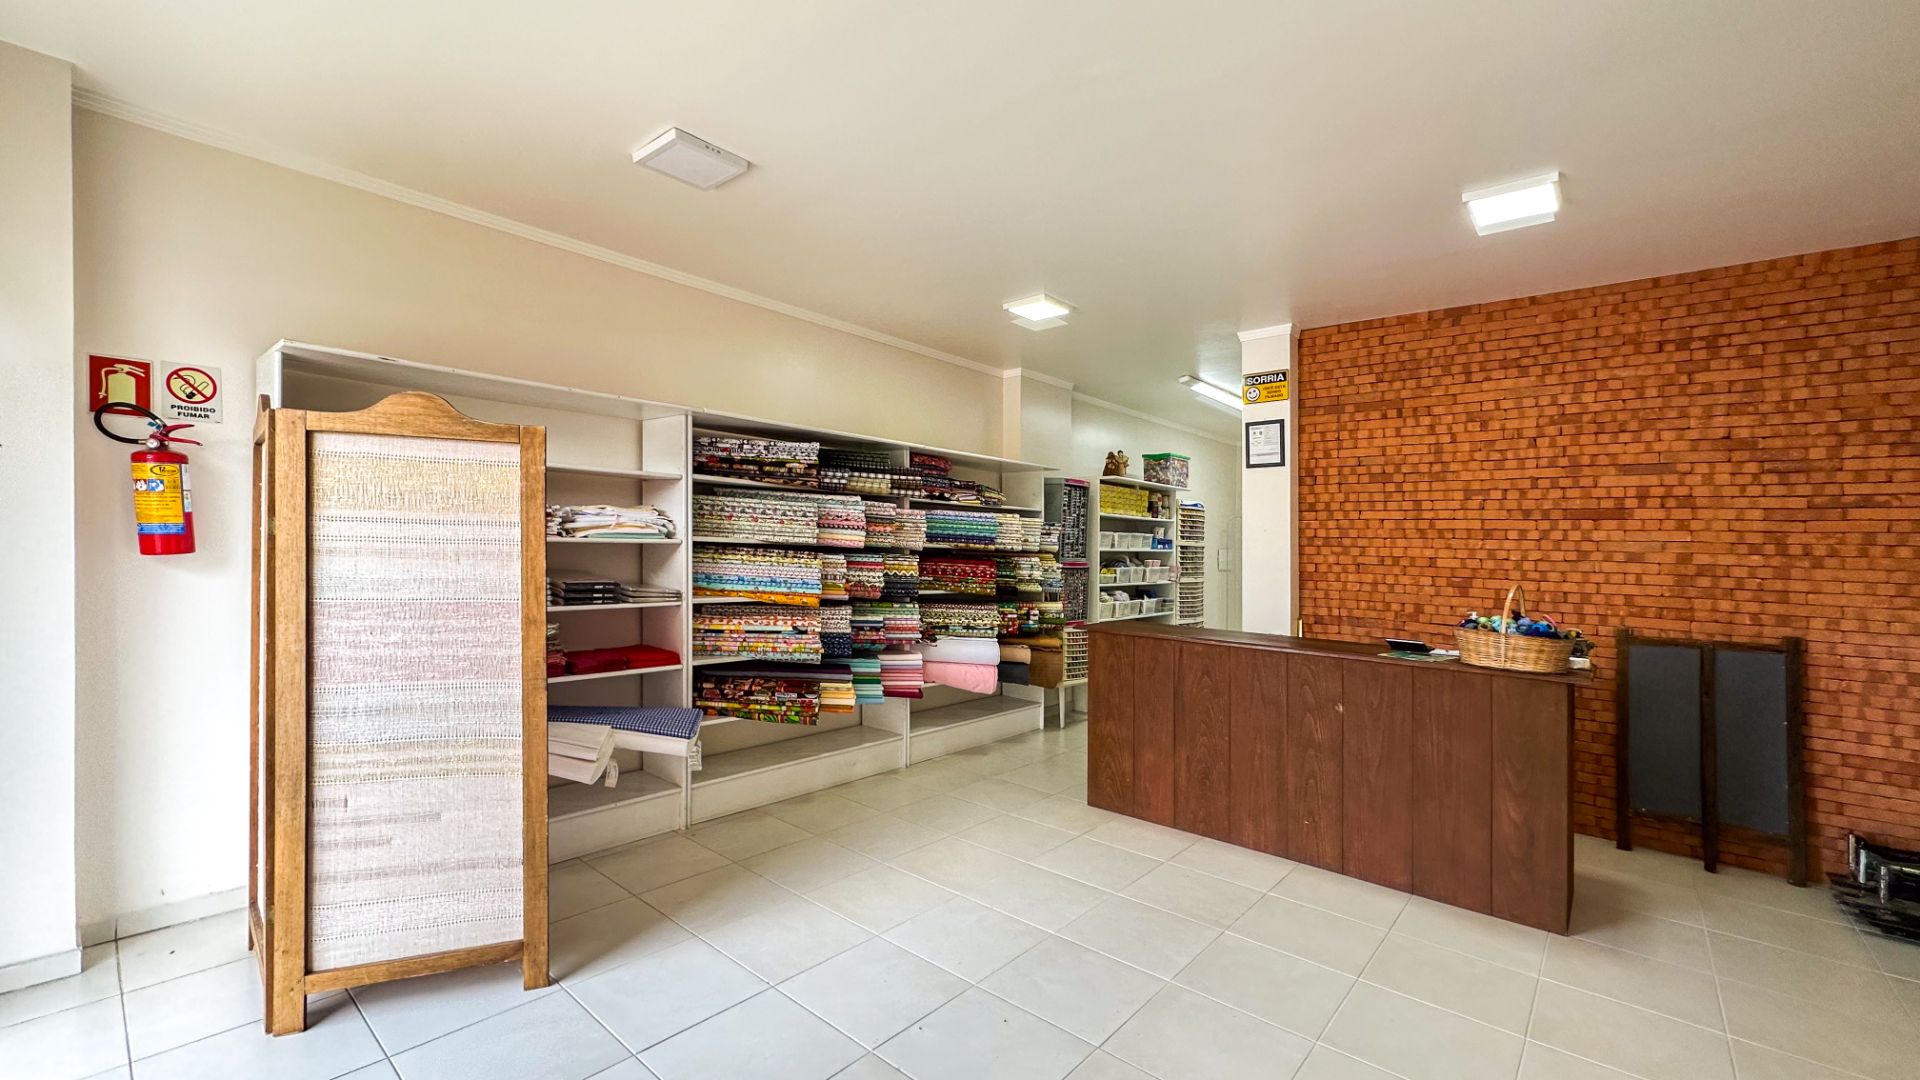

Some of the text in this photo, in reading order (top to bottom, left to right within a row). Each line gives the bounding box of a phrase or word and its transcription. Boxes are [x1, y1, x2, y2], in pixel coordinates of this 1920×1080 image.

[1246, 373, 1285, 385] SORRIA
[170, 404, 216, 413] PROIBIDO
[177, 411, 210, 419] FUMAR
